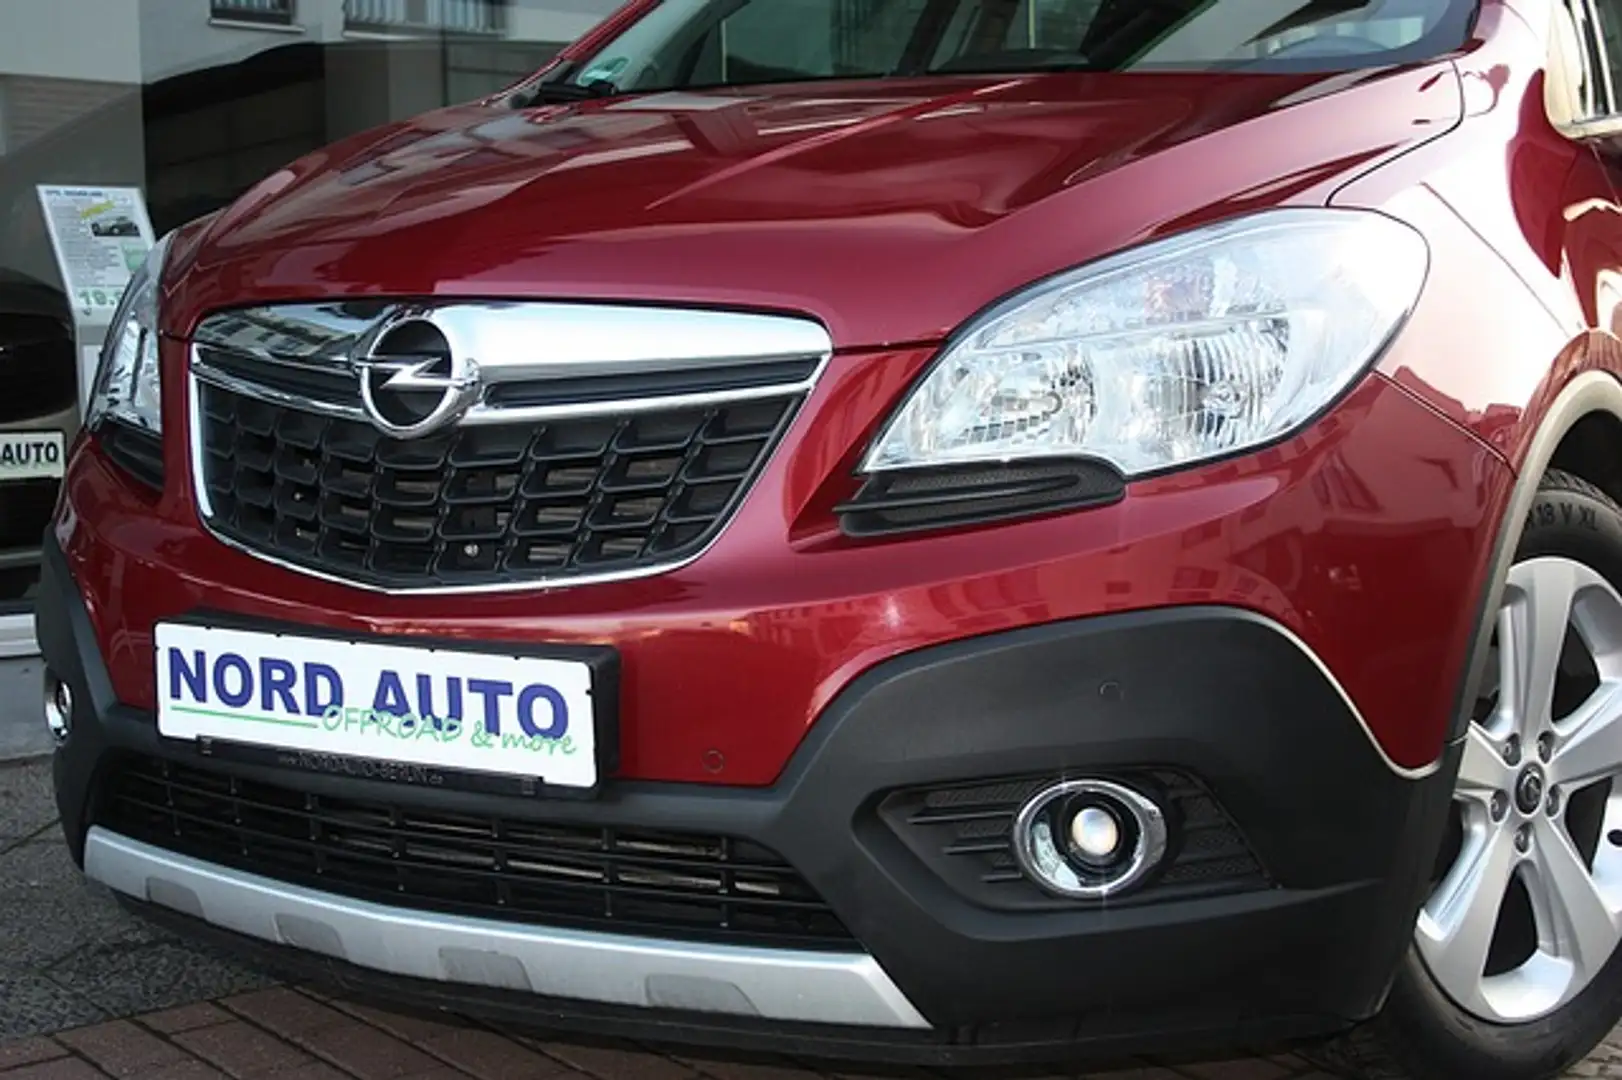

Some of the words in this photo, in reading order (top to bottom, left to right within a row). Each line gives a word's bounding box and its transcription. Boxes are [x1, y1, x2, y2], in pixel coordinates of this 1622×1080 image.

[1, 441, 59, 465] AUTO
[168, 646, 345, 718] NORD
[370, 669, 570, 741] AUTO
[322, 704, 464, 743] OFFROAD
[470, 720, 495, 749] &
[501, 731, 578, 756] more
